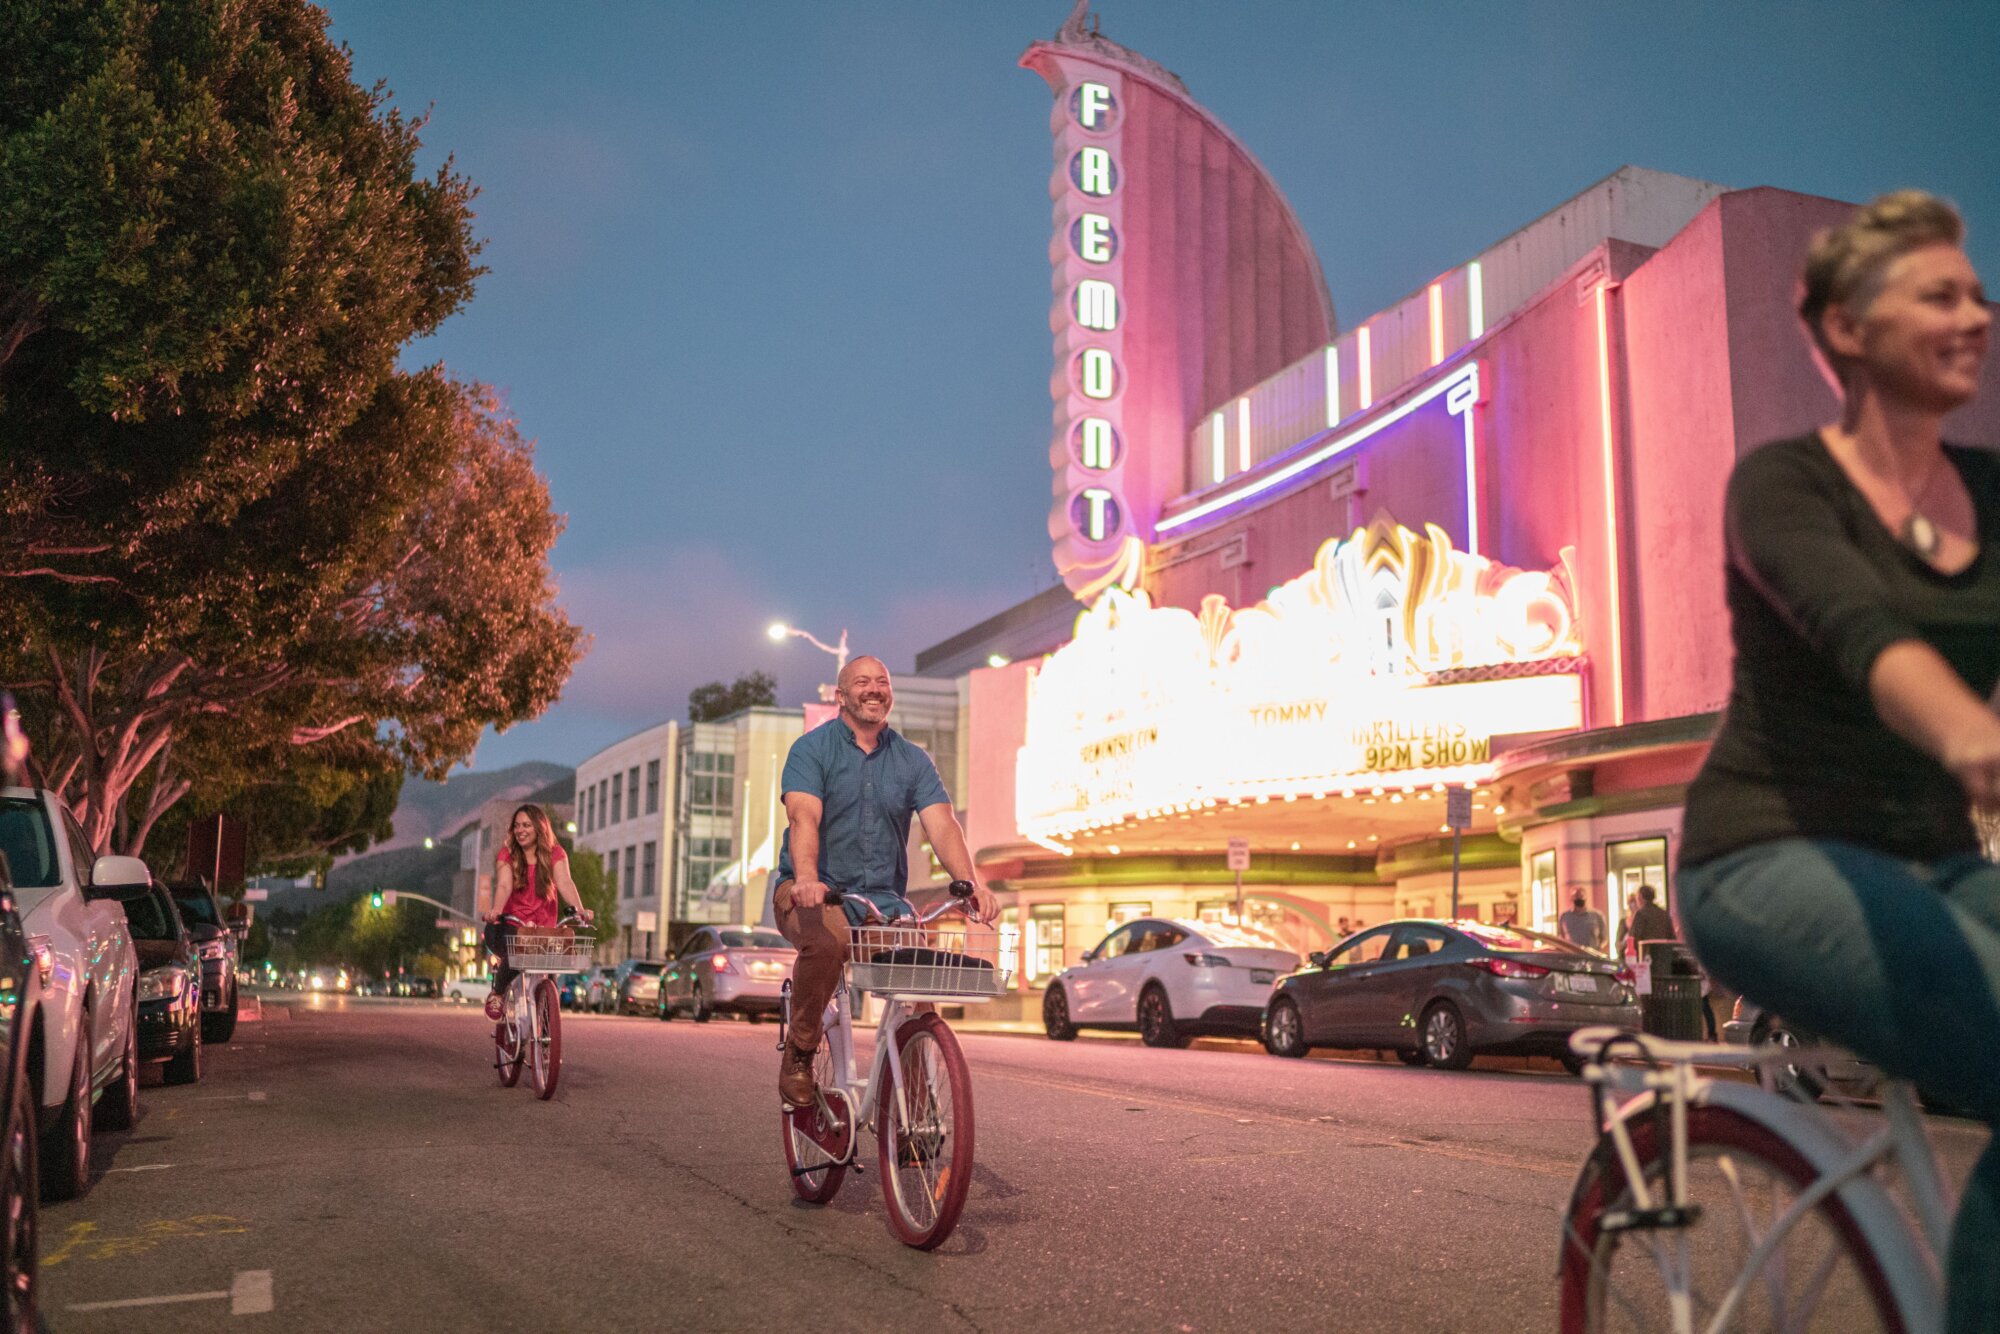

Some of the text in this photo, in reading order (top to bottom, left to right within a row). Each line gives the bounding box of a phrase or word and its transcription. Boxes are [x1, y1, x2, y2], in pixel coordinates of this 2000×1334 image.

[1078, 82, 1117, 541] FREMONT
[1249, 702, 1328, 728] TOMMY
[1365, 738, 1489, 769] 9PM SHOW
